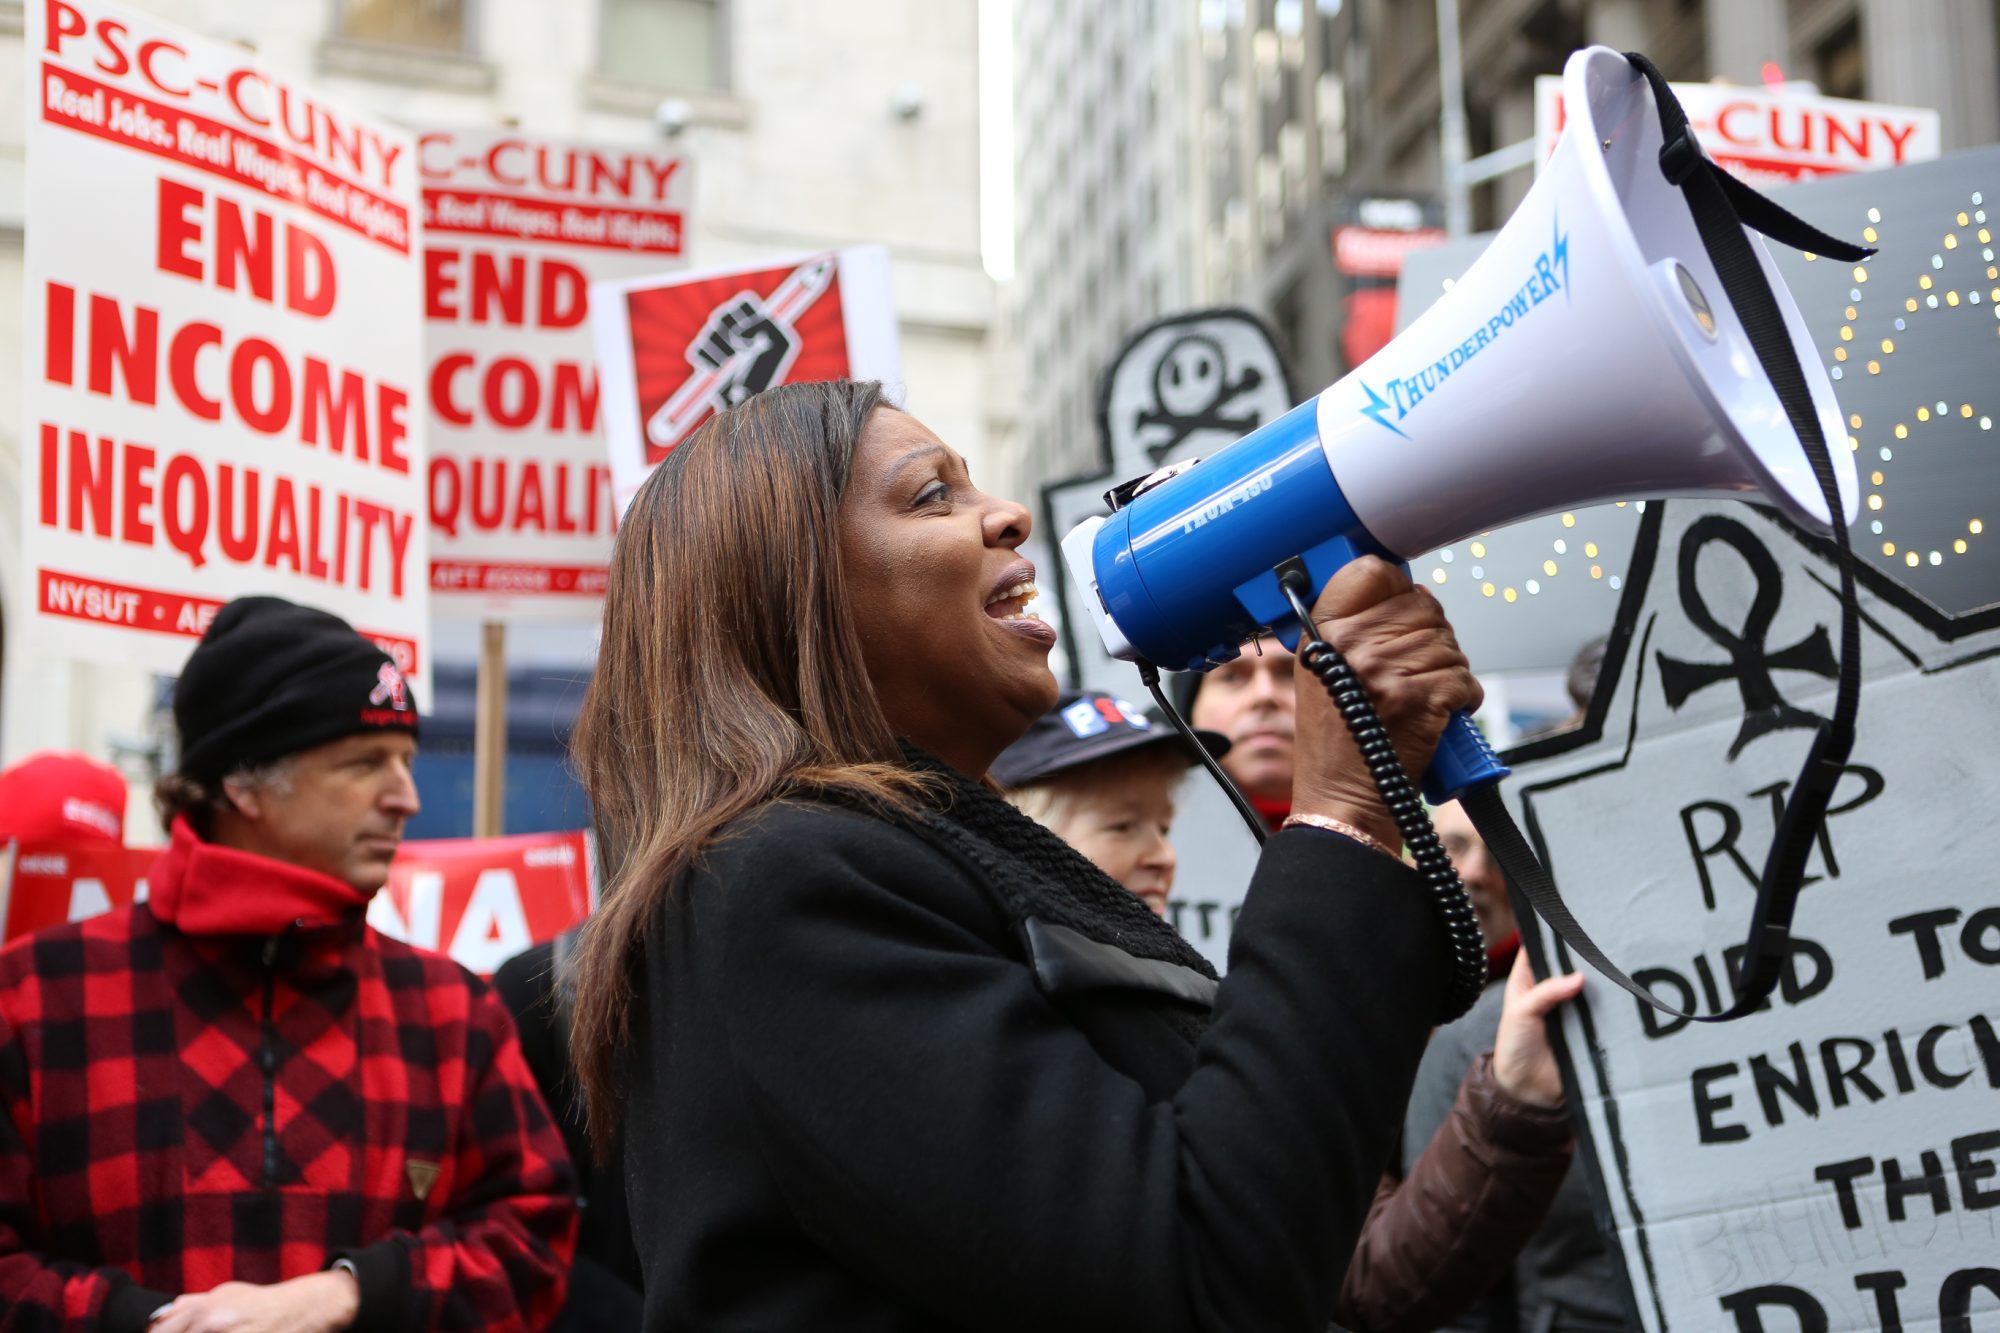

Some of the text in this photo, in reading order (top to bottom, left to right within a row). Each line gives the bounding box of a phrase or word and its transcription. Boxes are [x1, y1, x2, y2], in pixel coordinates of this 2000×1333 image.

[46, 0, 401, 187] PSC-CUNY
[47, 75, 105, 126] Real
[109, 97, 174, 148] Jobs.
[177, 118, 232, 168] Real
[156, 176, 336, 320] END
[424, 249, 588, 329] END
[45, 281, 410, 475] INCOME
[1386, 252, 1561, 421] THUNDERPOWER
[39, 423, 413, 600] INEQUALITY
[48, 578, 140, 624] NYSUT
[1814, 1130, 2000, 1230] THE
